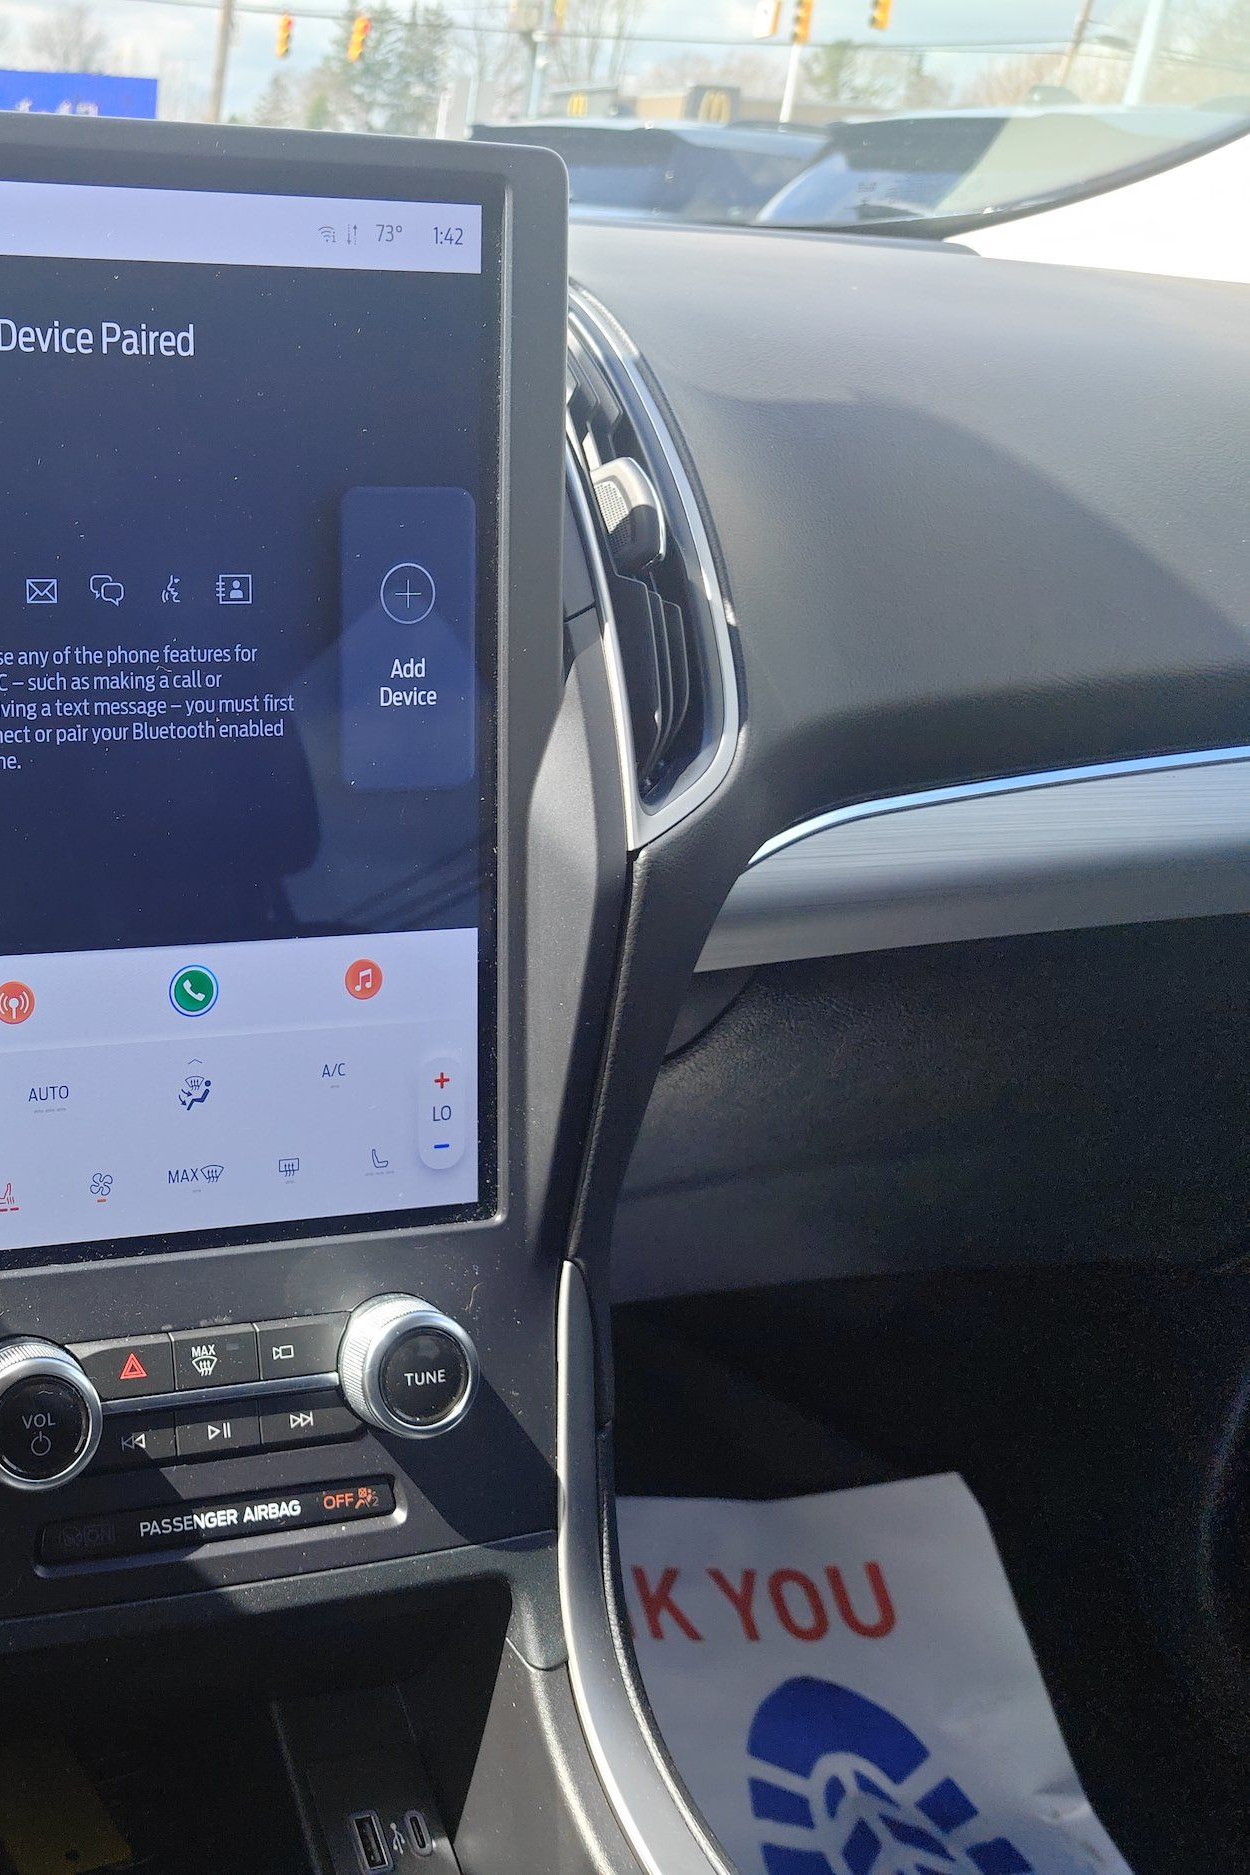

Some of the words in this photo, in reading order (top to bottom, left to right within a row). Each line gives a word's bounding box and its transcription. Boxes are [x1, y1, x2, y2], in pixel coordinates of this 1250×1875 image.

[375, 224, 403, 243] 73°
[433, 226, 464, 246] 1:42
[101, 322, 195, 357] Paired
[17, 651, 49, 669] any
[52, 646, 72, 665] of
[75, 646, 103, 664] the
[106, 645, 160, 667] phone
[163, 645, 232, 663] features
[234, 644, 258, 662] for
[390, 657, 426, 679] Add
[27, 671, 67, 691] such
[70, 676, 90, 690] as
[93, 671, 156, 692] making
[159, 675, 169, 689] a
[173, 670, 201, 688] call
[205, 674, 223, 687] or
[40, 703, 51, 717] a
[54, 699, 90, 716] text
[94, 700, 167, 717] message
[185, 699, 215, 716] you
[218, 695, 259, 713] must
[262, 694, 295, 712] first
[380, 686, 438, 707] Device
[34, 729, 52, 743] or
[55, 725, 88, 745] pair
[91, 725, 129, 744] your
[132, 720, 215, 740] Bluetooth
[219, 719, 284, 738] enabled
[321, 1062, 346, 1078] A/C
[28, 1085, 69, 1103] AUTO
[432, 1104, 452, 1122] LO
[168, 1168, 200, 1184] MAX
[191, 1346, 216, 1358] MAX
[403, 1368, 446, 1387] TUNE
[21, 1412, 56, 1429] VOL
[139, 1508, 238, 1537] PASSENGER
[243, 1499, 302, 1523] AIRBAG
[323, 1496, 353, 1510] OFF
[706, 1560, 897, 1642] YOU
